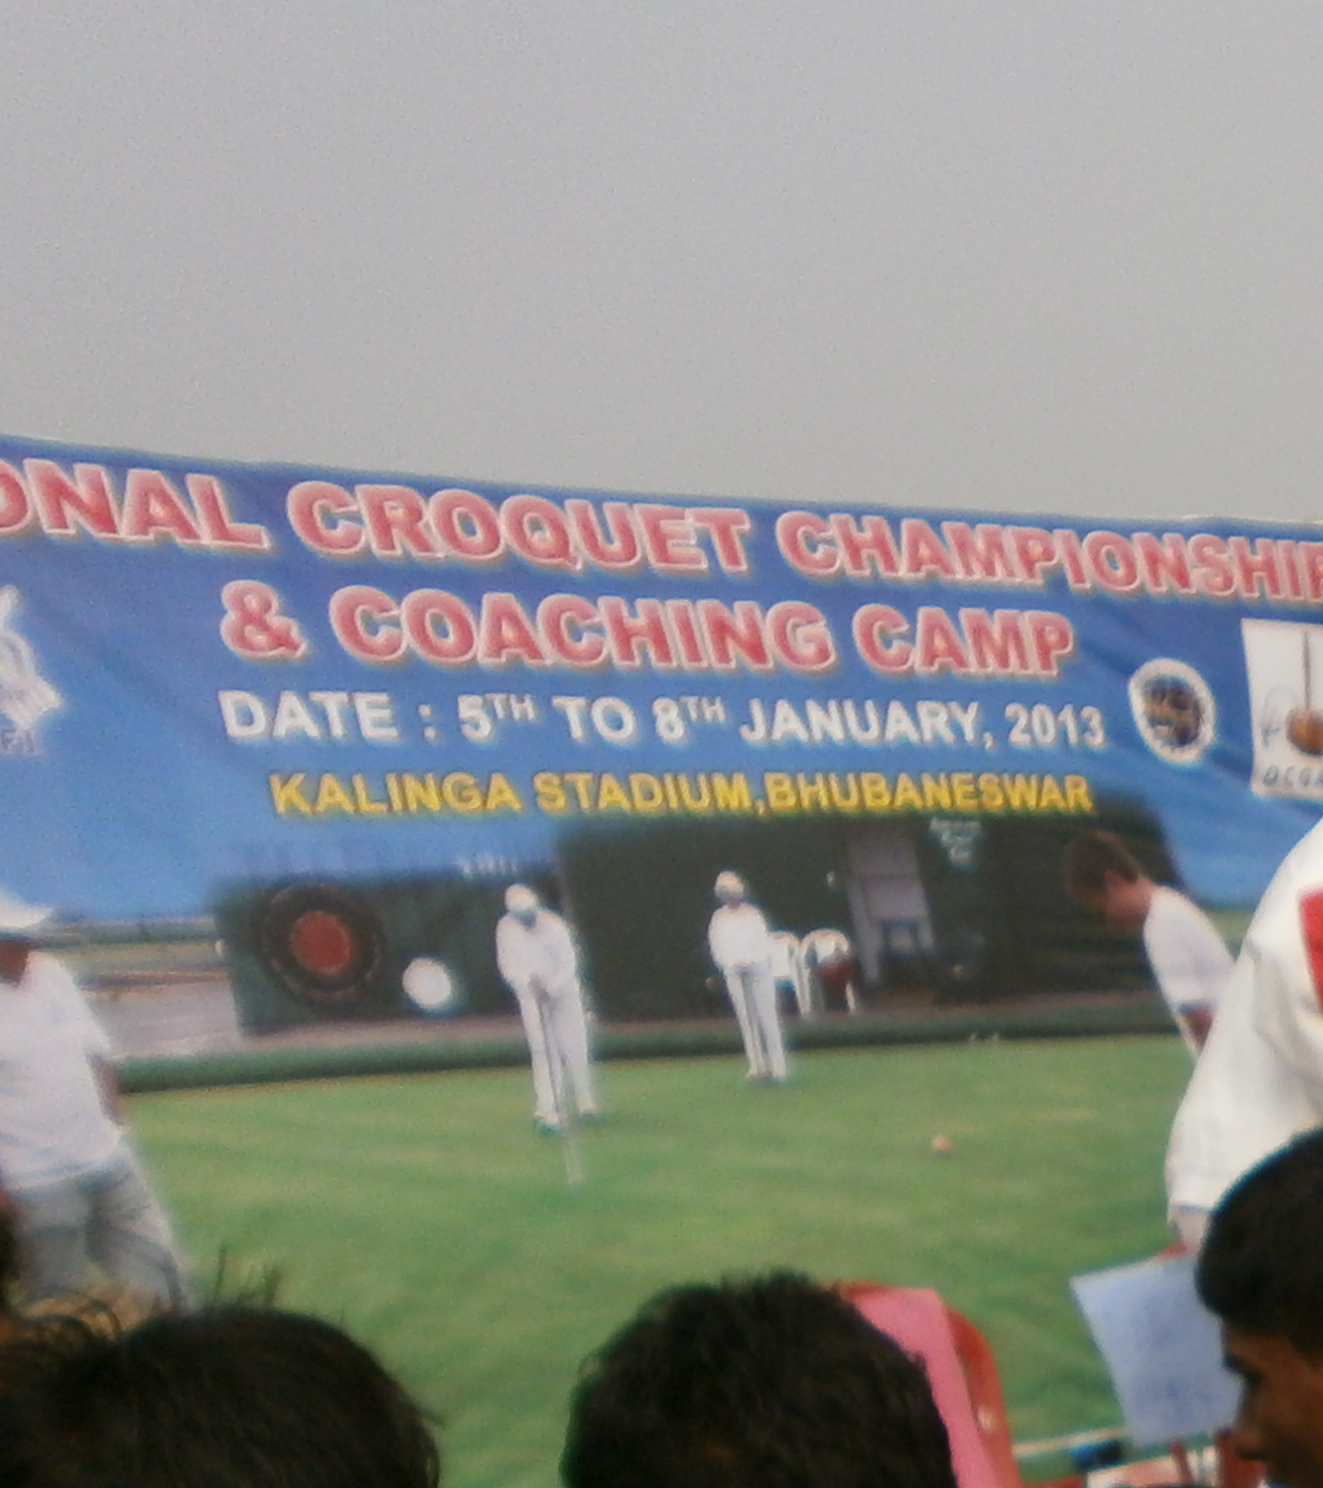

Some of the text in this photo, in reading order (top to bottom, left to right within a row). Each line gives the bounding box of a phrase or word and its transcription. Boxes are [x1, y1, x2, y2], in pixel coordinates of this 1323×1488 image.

[286, 481, 750, 573] CROQUET
[219, 580, 1074, 676] & COACHING CAMP
[217, 690, 399, 740] DATE
[551, 696, 638, 741] TO
[739, 698, 995, 749] JANUARY,
[1004, 702, 1106, 748] 2013
[269, 772, 524, 814] KALINGA
